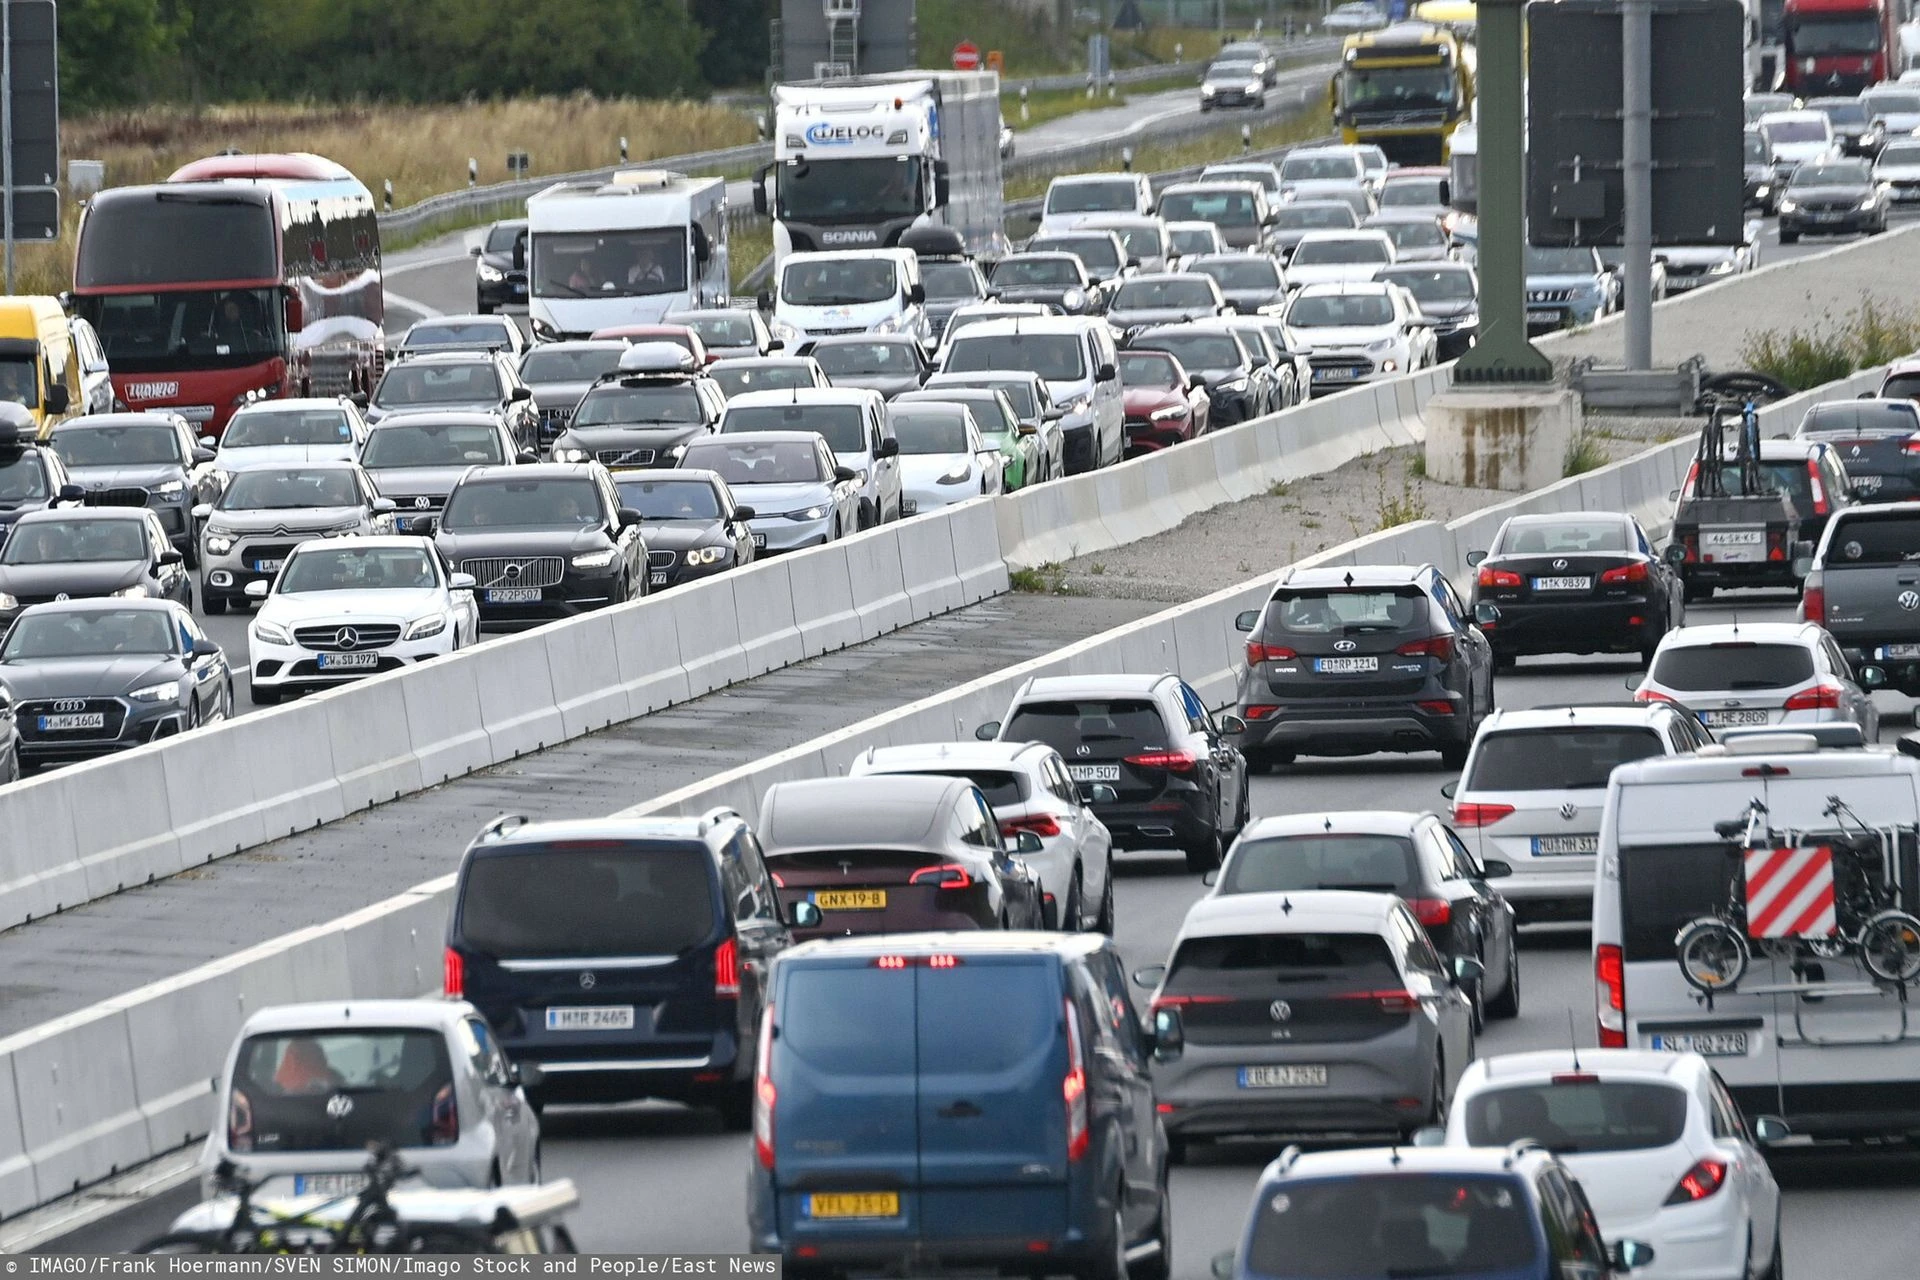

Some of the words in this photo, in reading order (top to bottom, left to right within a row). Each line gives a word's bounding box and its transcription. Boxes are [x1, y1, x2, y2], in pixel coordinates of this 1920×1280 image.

[822, 230, 878, 243] SCANIA
[1562, 577, 1586, 588] 9839
[355, 654, 377, 664] 1971
[1339, 658, 1351, 669] RP
[1354, 657, 1377, 669] 1214
[75, 714, 102, 726] 1604
[1738, 711, 1767, 723] 2809
[1079, 767, 1094, 778] MP
[1096, 766, 1118, 778] 507
[819, 893, 880, 907] GNX-19-B
